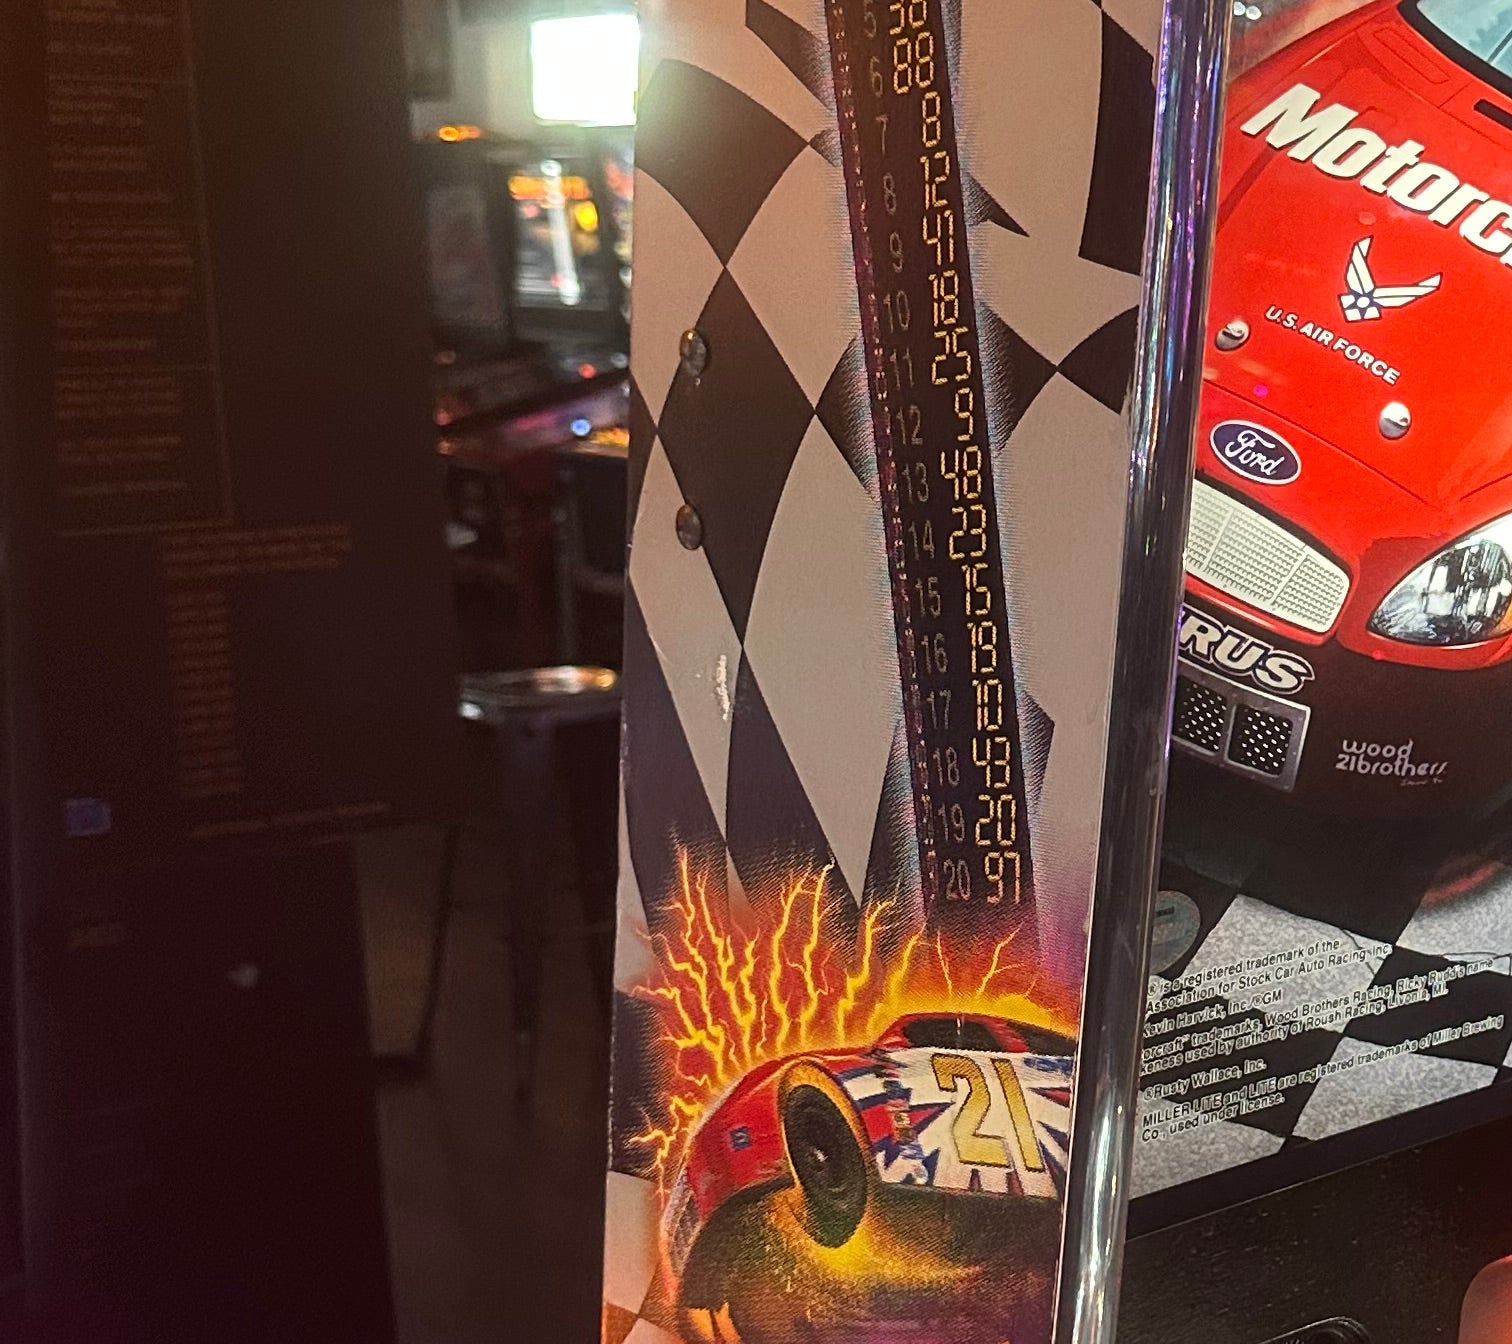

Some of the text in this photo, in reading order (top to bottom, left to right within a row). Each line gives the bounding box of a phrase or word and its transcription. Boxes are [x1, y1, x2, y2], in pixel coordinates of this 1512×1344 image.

[869, 31, 934, 99] 6 88
[875, 91, 941, 156] 7 8
[882, 150, 950, 216] 8 12
[889, 210, 954, 273] 9 41
[882, 269, 959, 334] 10 18
[888, 326, 973, 392] 11 25
[1265, 306, 1401, 386] U.S. AIR FORCE
[896, 387, 974, 446] 12 9
[901, 445, 983, 504] 13 48
[1223, 429, 1287, 477] Ford
[908, 504, 987, 561] 14 23
[914, 562, 991, 618] 15 15
[921, 620, 997, 675] 16 19
[926, 678, 1003, 731] 17 10
[932, 736, 1011, 789] 18 43
[1342, 739, 1413, 757] wood
[937, 793, 1017, 847] 19 20
[943, 850, 1021, 905] 20 97
[1147, 984, 1215, 1015] Association
[1218, 979, 1236, 997] for
[1238, 969, 1272, 991] Stock
[1275, 964, 1295, 982] Car
[1299, 956, 1325, 975] Auto
[1160, 980, 1172, 993] is
[1183, 963, 1244, 990] registered
[1246, 946, 1305, 972] trademark
[1307, 941, 1321, 957] of
[1321, 938, 1340, 954] the
[1265, 1008, 1299, 1028] Wood
[1302, 994, 1351, 1018] Brothers
[1353, 984, 1396, 1006] Racing,
[1396, 973, 1428, 993] Ricky
[1466, 957, 1495, 976] name
[1185, 1042, 1216, 1065] used
[1217, 1037, 1236, 1058] by
[1235, 1020, 1290, 1050] authority
[1290, 1018, 1305, 1036] of
[1305, 1009, 1343, 1032] Roush
[1344, 999, 1387, 1022] Racing,
[1141, 1013, 1505, 1129] MILLER LITE and LITE are registered trademarks of Miller Brewing
[1191, 1064, 1243, 1090] Wallace,
[1243, 1056, 1268, 1075] Inc.
[930, 1053, 1046, 1172] 21
[1168, 1114, 1200, 1136] used
[1202, 1102, 1239, 1126] under
[1239, 1091, 1286, 1116] license.
